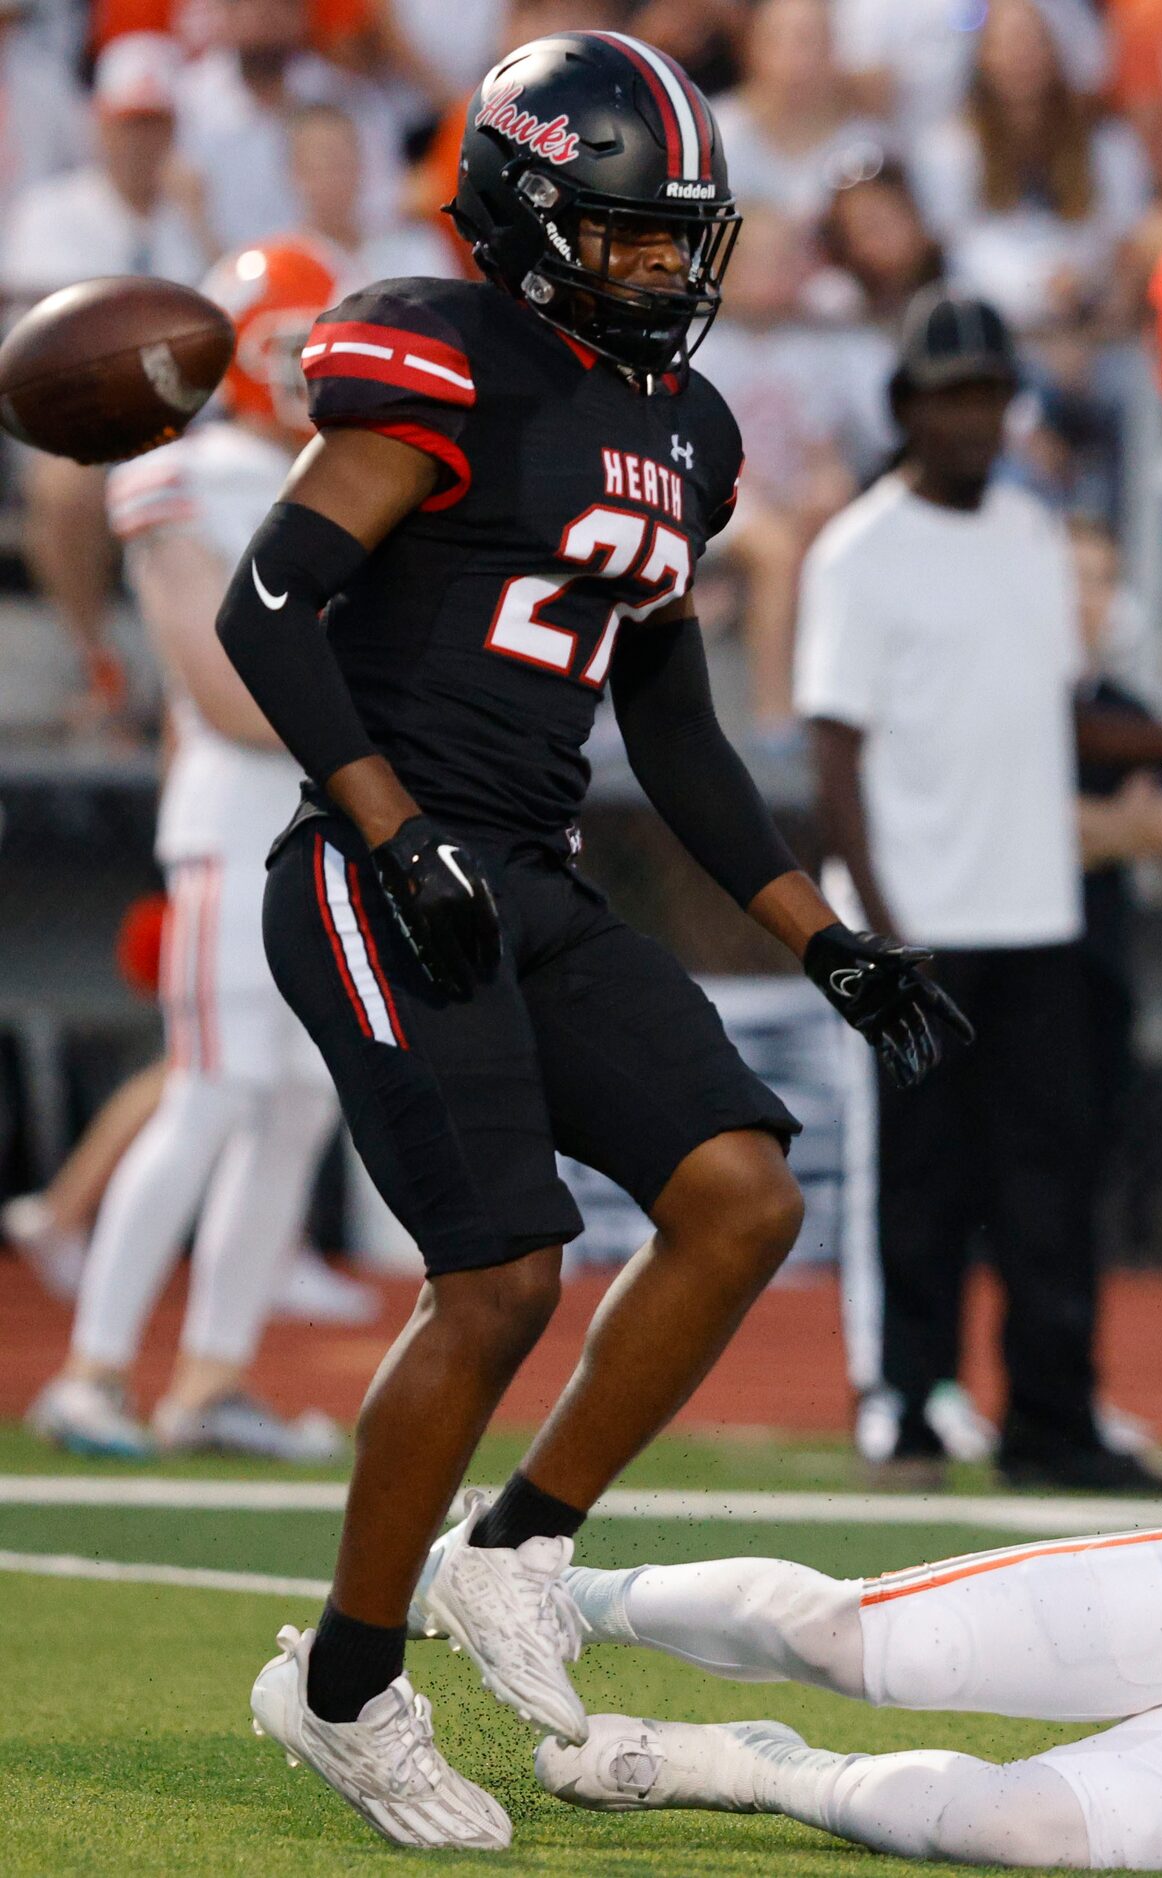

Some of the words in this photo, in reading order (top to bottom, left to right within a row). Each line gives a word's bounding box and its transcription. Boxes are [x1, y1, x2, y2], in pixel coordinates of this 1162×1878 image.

[475, 81, 580, 165] Hawks
[666, 182, 716, 200] Riddell
[545, 220, 583, 268] Ridd
[601, 447, 683, 523] HEATH
